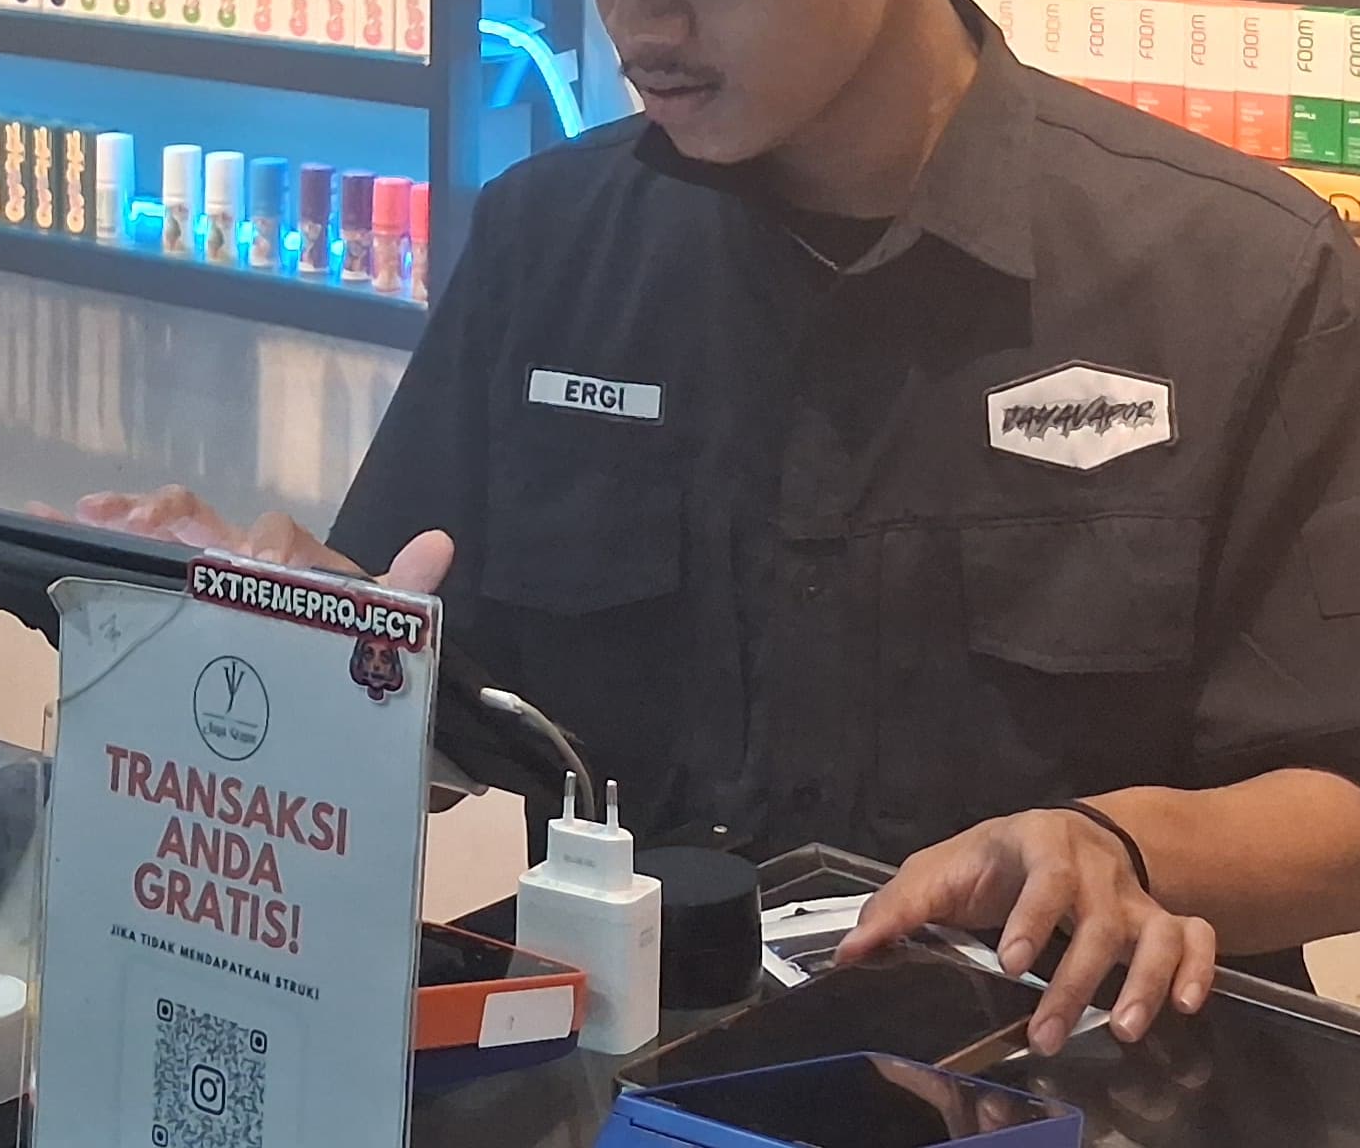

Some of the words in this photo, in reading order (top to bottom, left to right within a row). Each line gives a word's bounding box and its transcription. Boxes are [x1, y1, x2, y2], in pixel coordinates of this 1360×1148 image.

[1297, 19, 1314, 73] FOOM
[564, 379, 626, 412] ERGI
[193, 565, 423, 644] EXTREMEPROJECT
[105, 744, 348, 855] TRANSAKSI
[157, 815, 283, 894] ANDA
[133, 862, 301, 954] GRATIS!
[110, 924, 137, 942] JIKA
[140, 932, 176, 954] TIDAK
[179, 945, 271, 985] MENDAPATKAN
